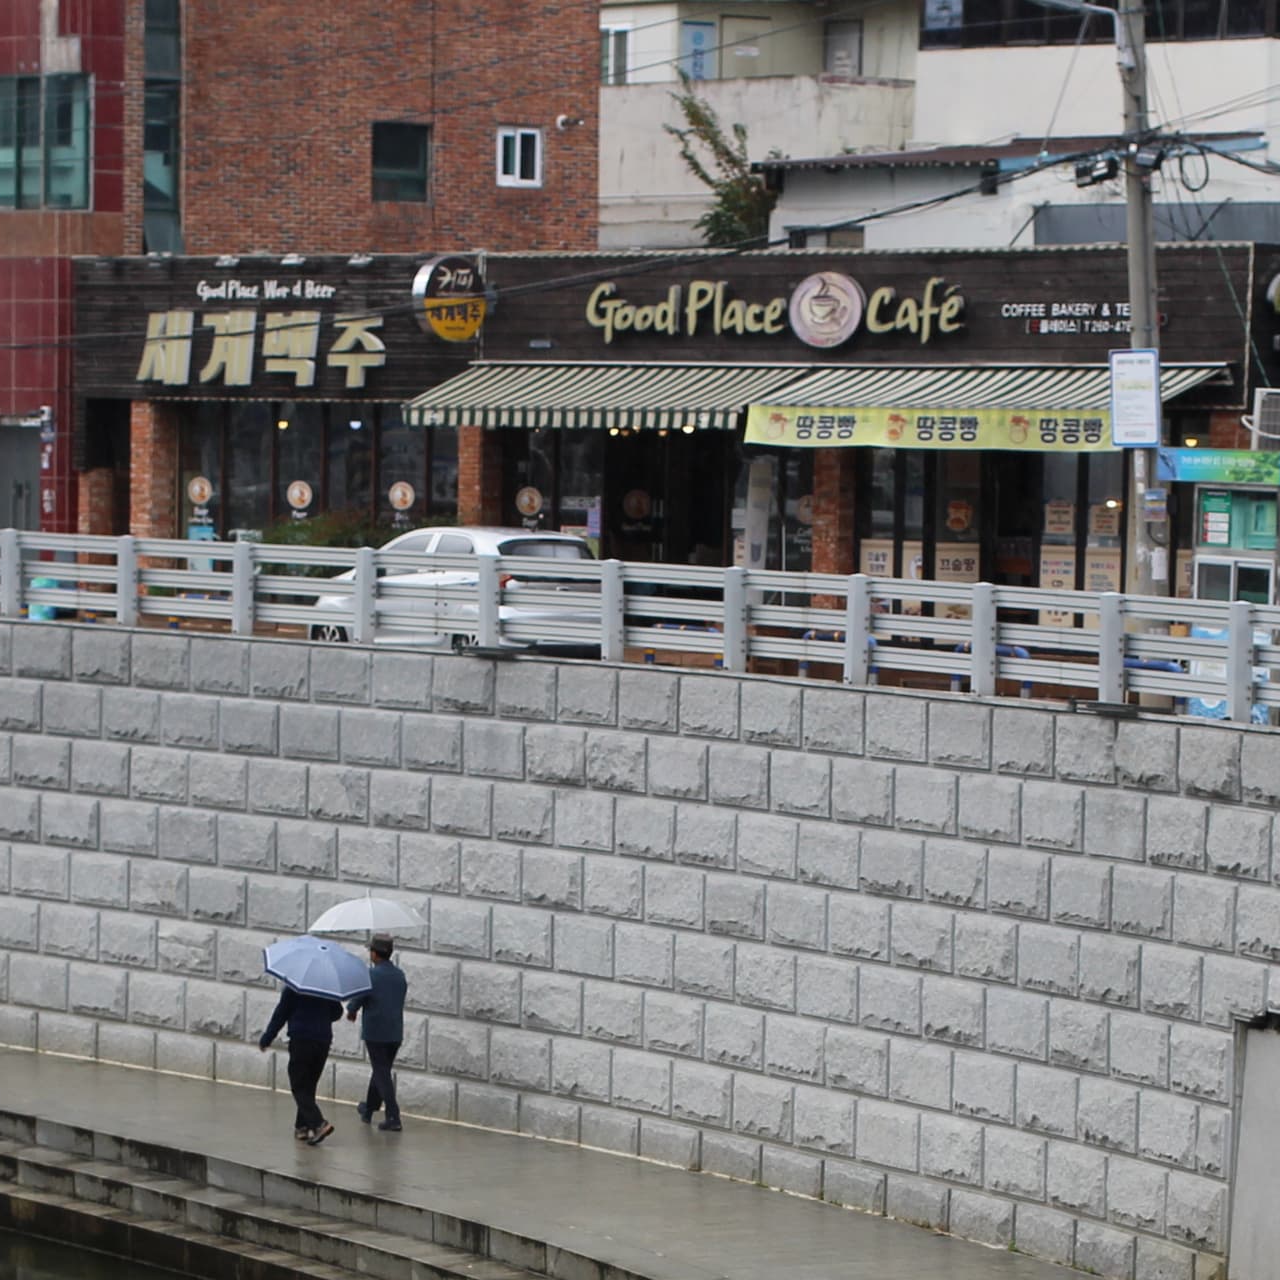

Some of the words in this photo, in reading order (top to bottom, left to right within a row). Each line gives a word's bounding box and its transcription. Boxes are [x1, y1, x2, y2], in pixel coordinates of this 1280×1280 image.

[304, 280, 336, 299] Beer
[586, 282, 679, 344] Good
[685, 280, 787, 336] Place
[865, 276, 966, 344] Café
[1001, 304, 1046, 317] COFFEE
[1051, 303, 1098, 317] BAKERY
[136, 309, 387, 388] 세계맥주
